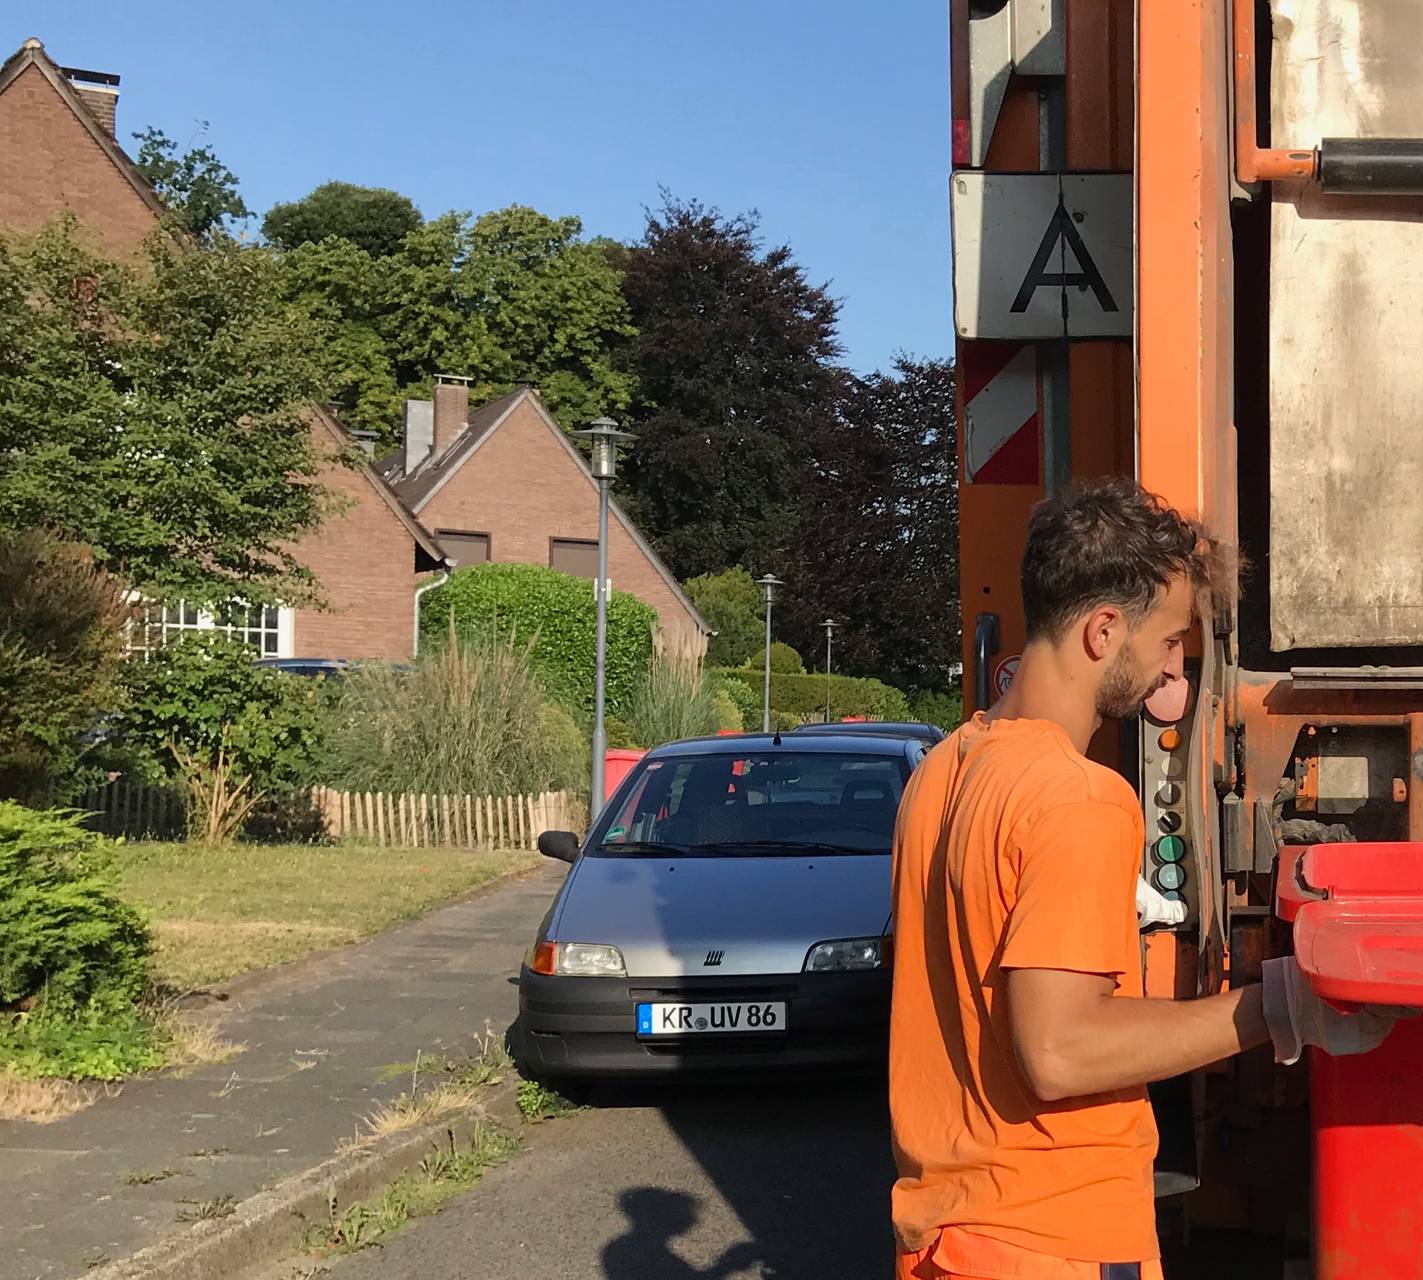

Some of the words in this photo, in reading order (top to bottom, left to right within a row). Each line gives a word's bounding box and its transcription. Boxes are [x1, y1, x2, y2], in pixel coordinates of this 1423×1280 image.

[1010, 203, 1119, 312] A
[662, 1007, 693, 1029] KR
[710, 1005, 742, 1028] UV
[747, 1005, 777, 1027] 86
